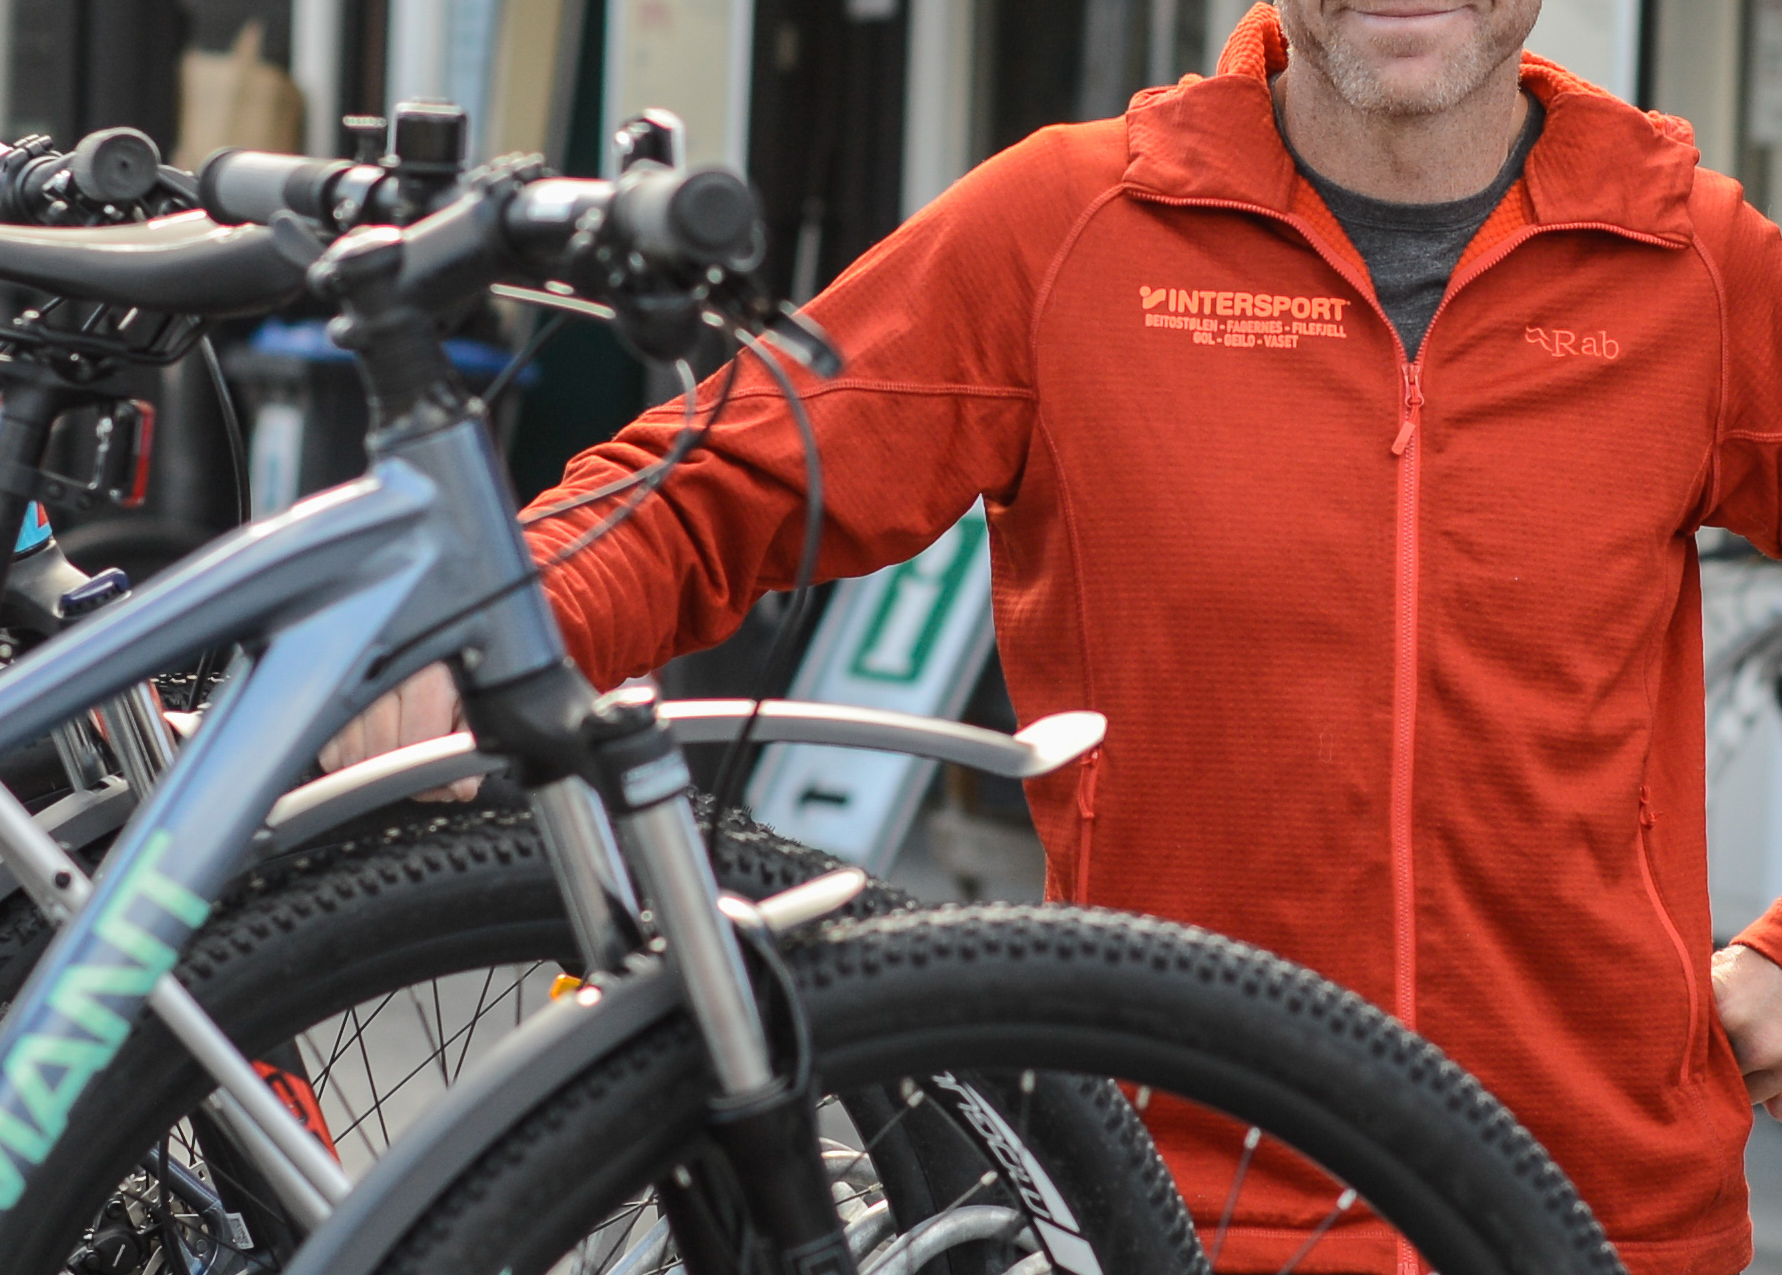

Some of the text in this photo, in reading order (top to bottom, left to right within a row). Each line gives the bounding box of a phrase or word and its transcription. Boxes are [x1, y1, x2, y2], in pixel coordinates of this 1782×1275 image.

[1169, 287, 1348, 321] INTERSPORT
[1193, 332, 1215, 345] GOL
[1224, 334, 1255, 347] GEILO
[1264, 335, 1299, 348] VASET
[1292, 322, 1347, 338] FILEFJELL
[1552, 330, 1619, 359] Rab
